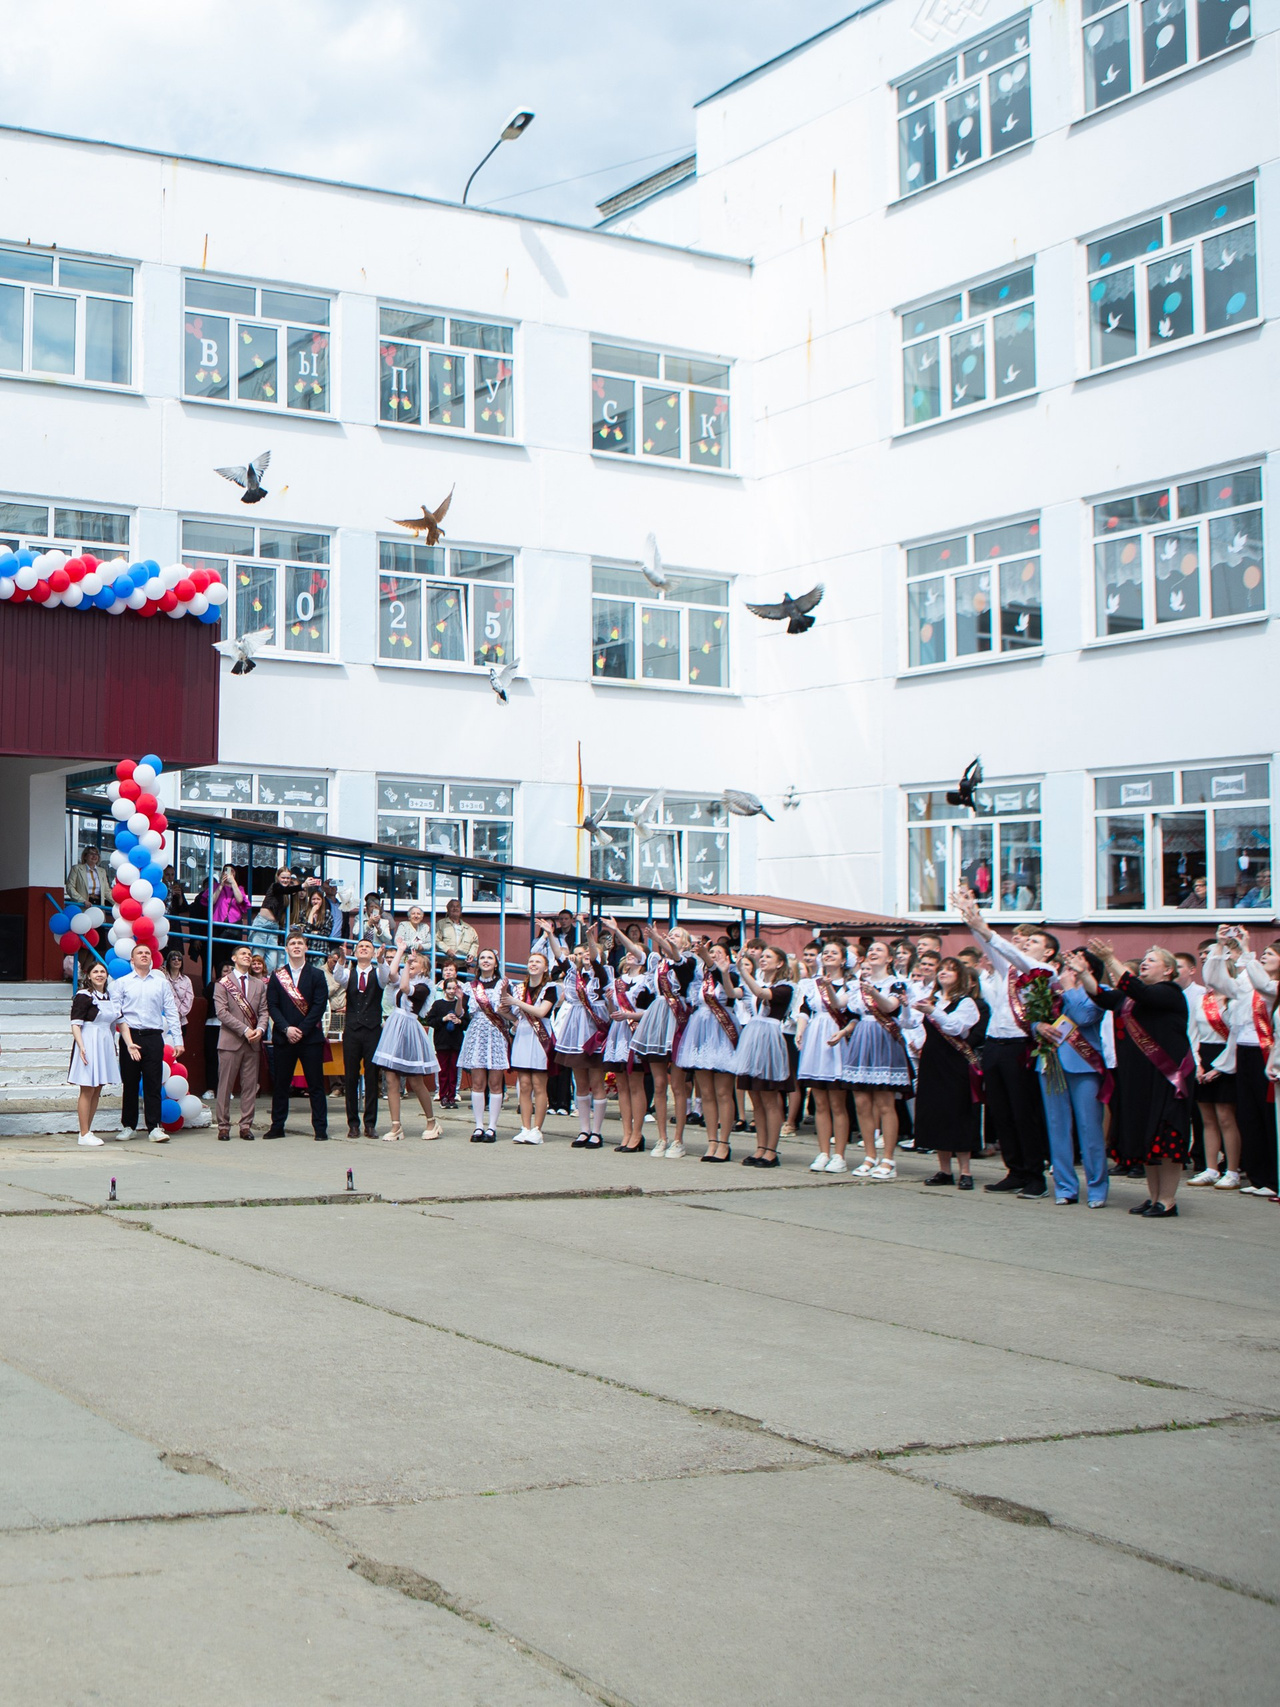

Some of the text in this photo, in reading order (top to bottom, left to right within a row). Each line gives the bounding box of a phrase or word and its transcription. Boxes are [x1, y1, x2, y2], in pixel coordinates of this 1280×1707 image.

[410, 800, 433, 808] 3+2=5
[460, 802, 483, 810] 3+3=6
[641, 843, 669, 868] 11
[651, 870, 664, 890] А
